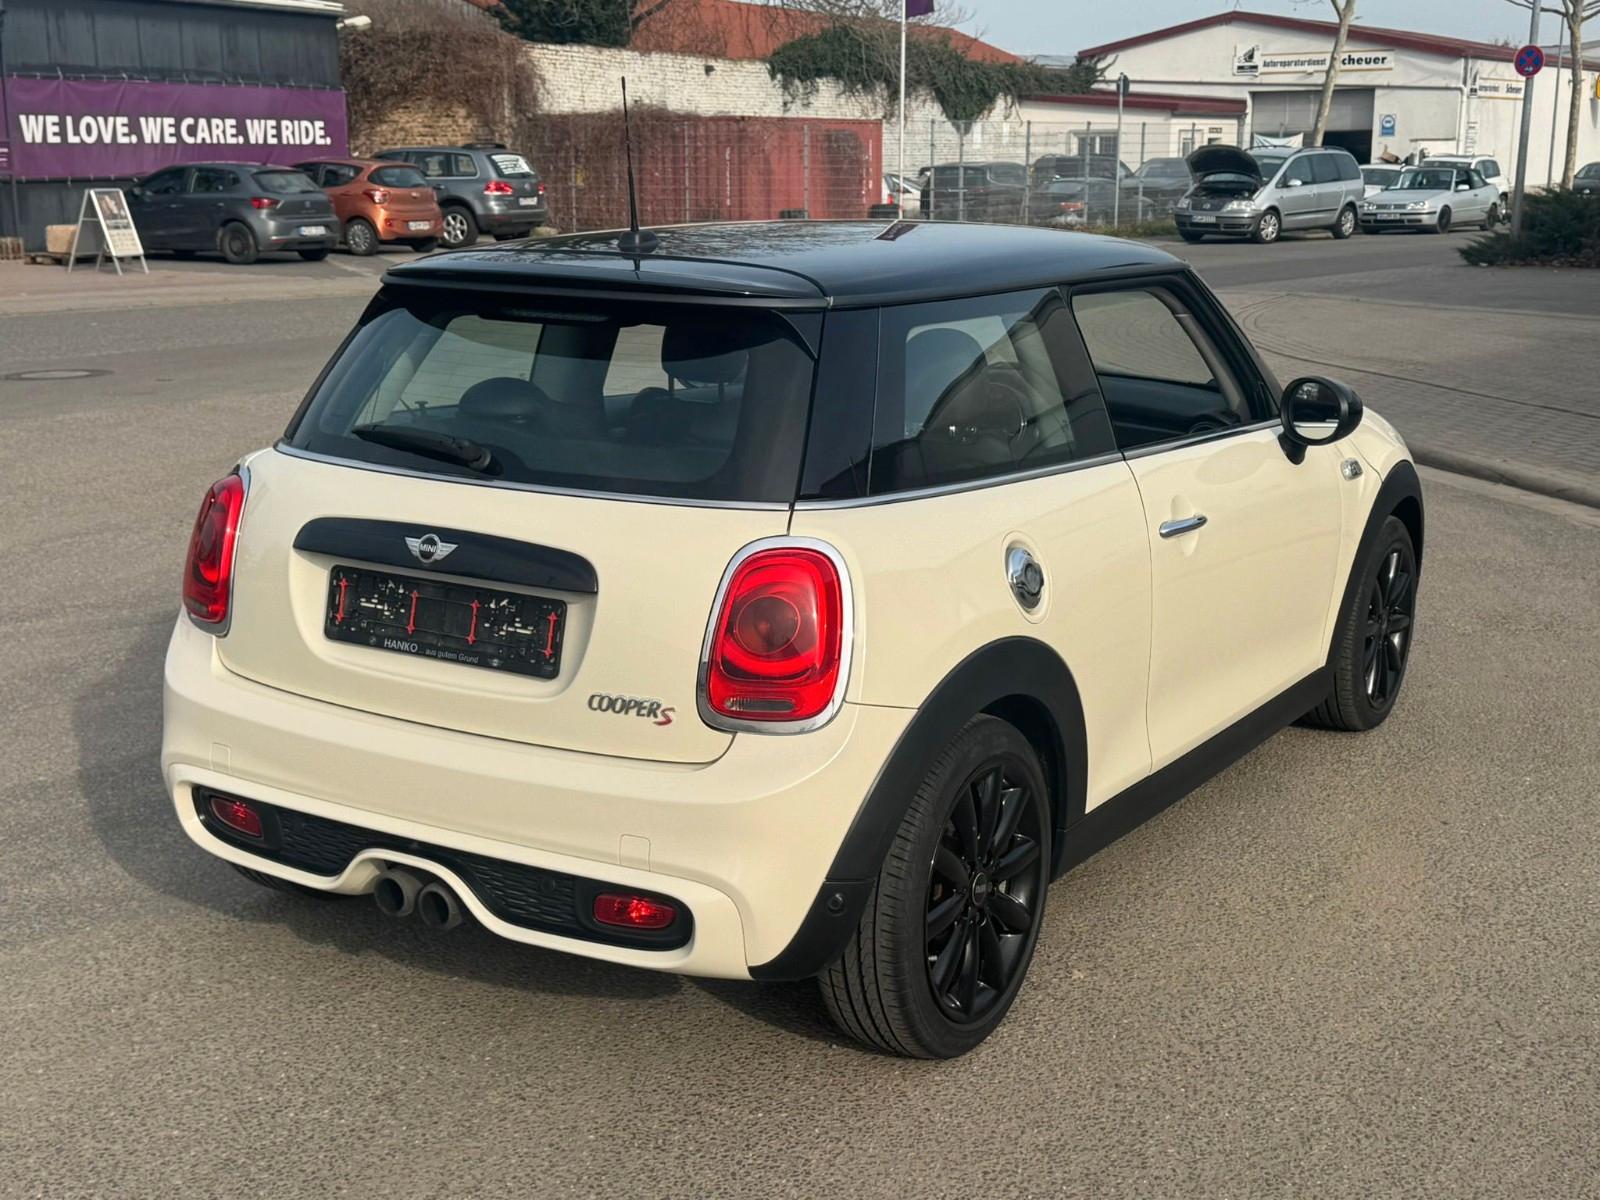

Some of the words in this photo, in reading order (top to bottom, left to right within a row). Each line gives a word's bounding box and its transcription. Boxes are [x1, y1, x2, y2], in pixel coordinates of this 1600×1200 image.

[1340, 54, 1388, 66] cheuer
[19, 114, 61, 143] WE
[66, 115, 137, 144] LOVE.
[140, 116, 177, 144] WE
[180, 117, 244, 144] CARE.
[246, 118, 278, 145] WE
[281, 120, 332, 145] RIDE.
[384, 638, 418, 653] HANKO
[458, 653, 479, 664] Grund
